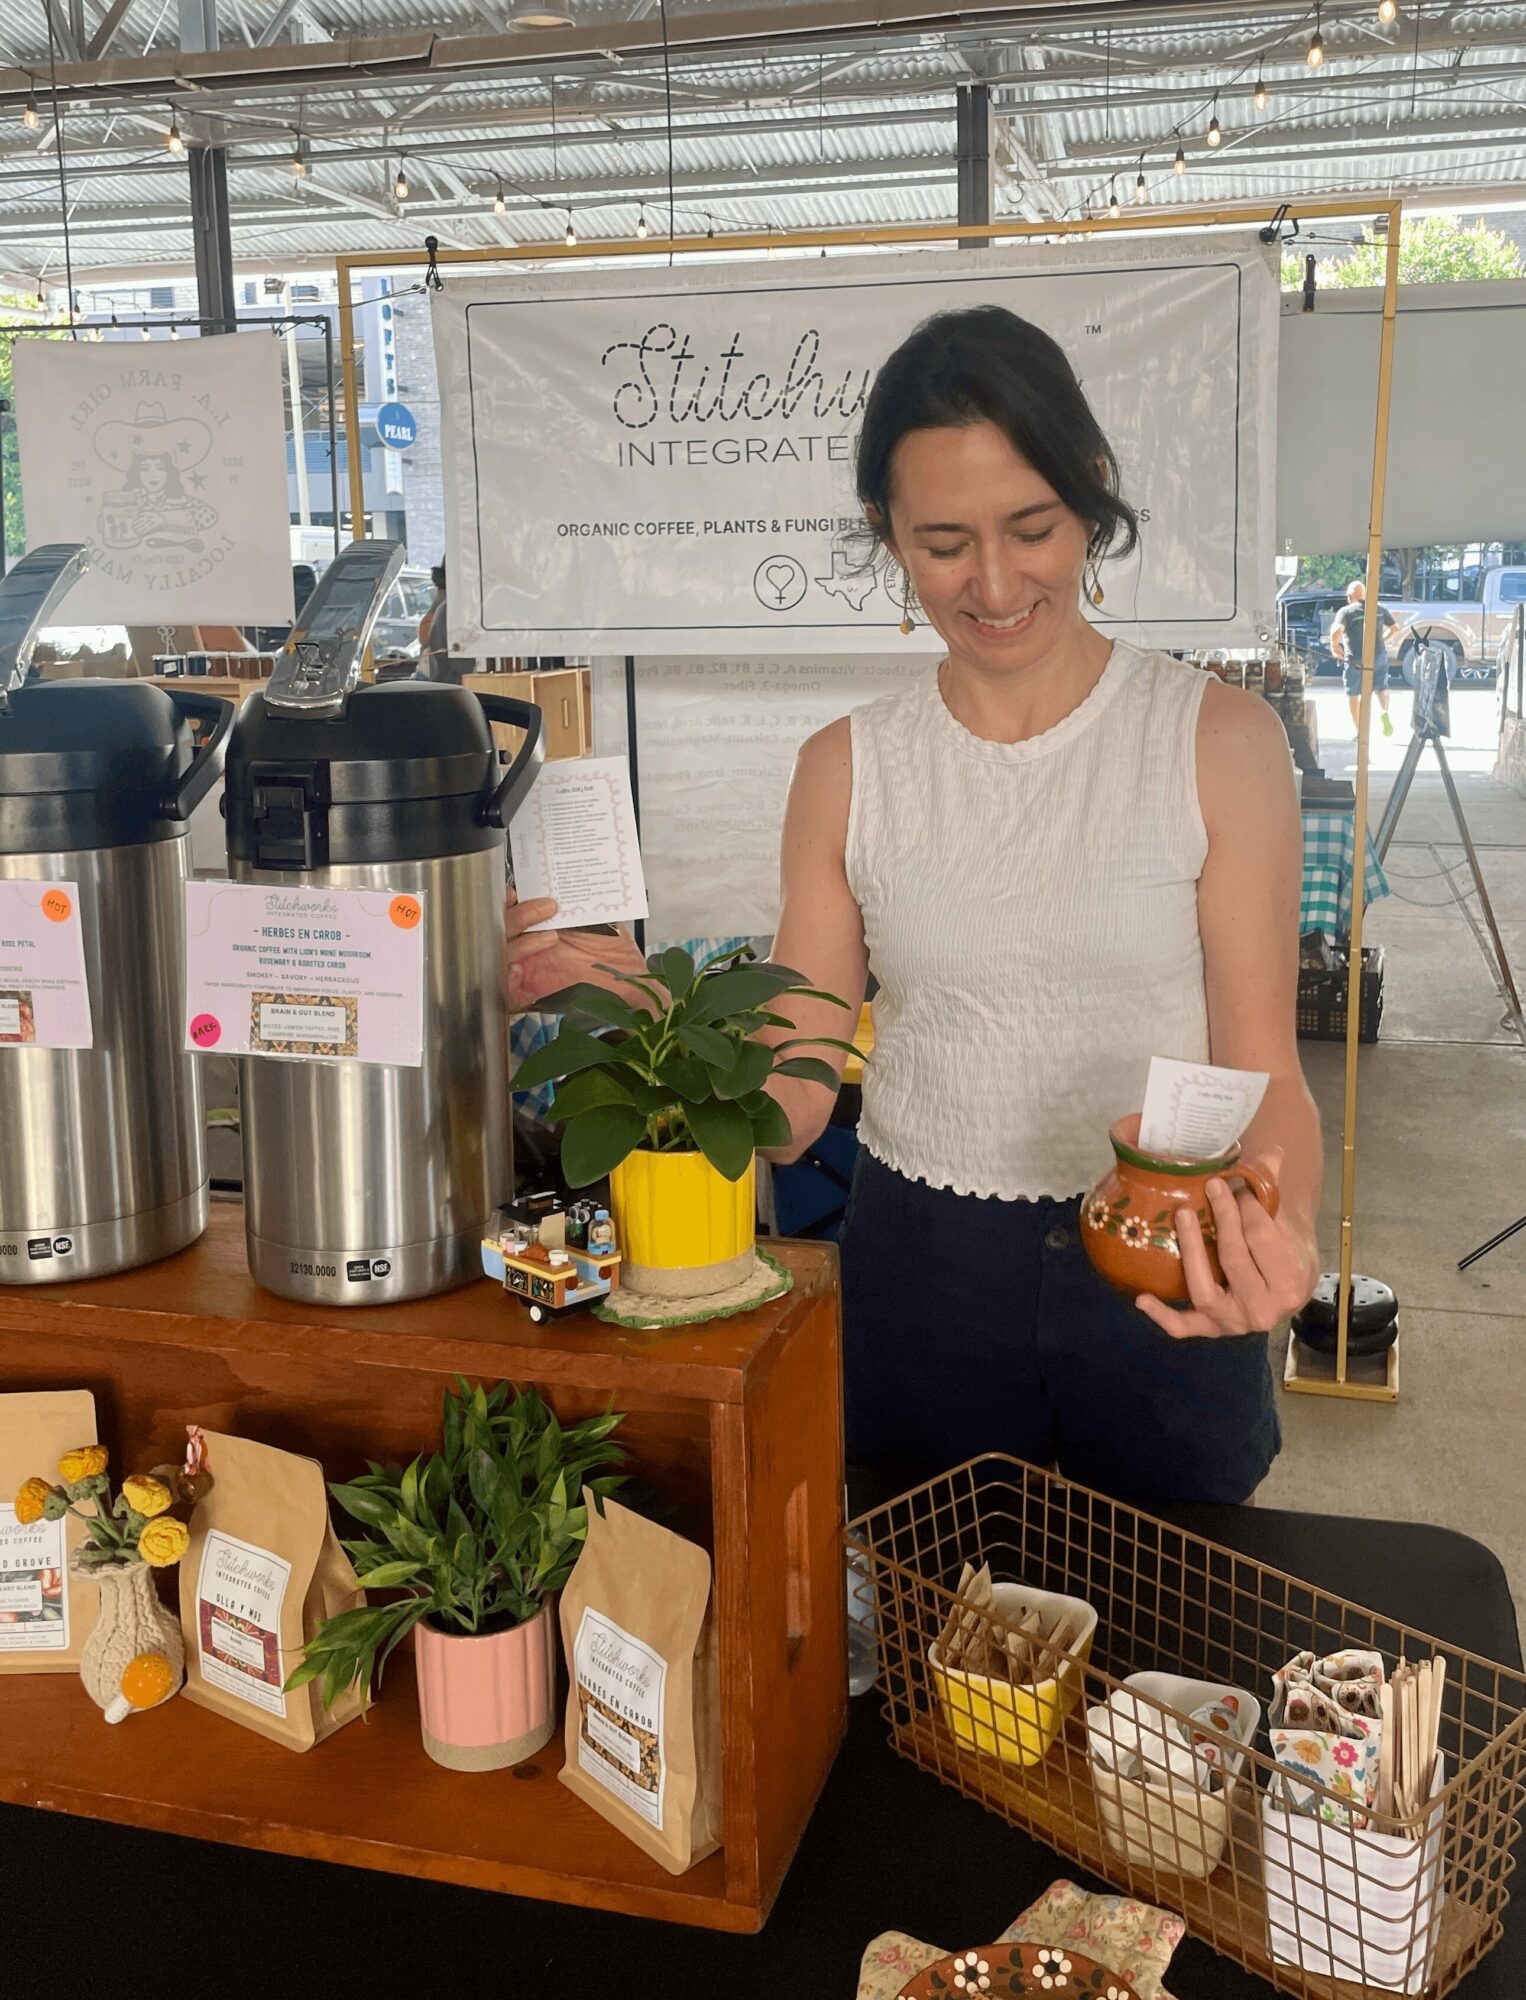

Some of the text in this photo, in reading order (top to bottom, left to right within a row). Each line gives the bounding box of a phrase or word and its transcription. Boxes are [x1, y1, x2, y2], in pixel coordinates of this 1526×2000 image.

[1084, 325, 1102, 335] TM
[384, 423, 414, 442] PEARL
[617, 435, 864, 468] INTEGRATE
[556, 522, 631, 537] ORGANIC
[634, 521, 699, 537] COFFEE,
[703, 519, 767, 534] PLANTS
[771, 519, 782, 533] &
[785, 518, 834, 533] FUNGI
[46, 899, 67, 915] HOT
[396, 902, 417, 921] HOT
[262, 926, 295, 938] HERBES
[299, 928, 310, 939] EN
[313, 930, 342, 941] CAROB
[232, 943, 257, 953] ORGANIC
[258, 945, 280, 954] COFFEE
[283, 947, 298, 956] WITH
[320, 949, 336, 957] MANE
[258, 957, 290, 966] ROSEMARY
[327, 961, 346, 969] CAROB
[315, 975, 360, 984] HERBACEOUS
[13, 1536, 42, 1544] COFFEE
[15, 1556, 52, 1568] GROVE
[215, 1570, 270, 1601] INTEGRATED COFFEE
[240, 1604, 245, 1613] Y
[625, 1676, 646, 1699] COFFEE
[579, 1671, 653, 1729] HERBES EN CAROB
